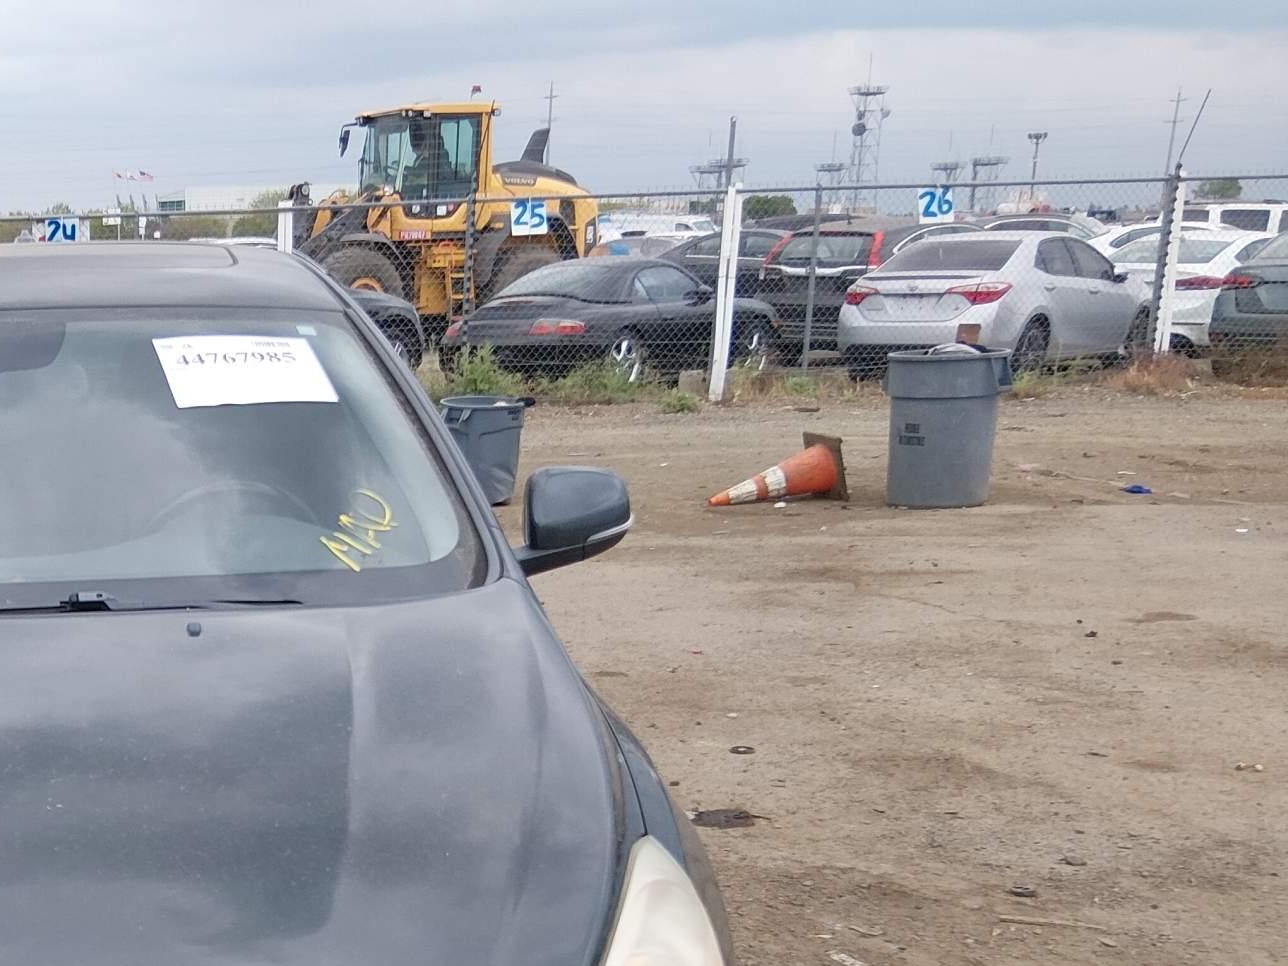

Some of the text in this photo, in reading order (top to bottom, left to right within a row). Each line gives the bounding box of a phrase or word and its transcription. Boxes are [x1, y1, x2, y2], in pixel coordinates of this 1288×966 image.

[512, 201, 545, 228] 25
[918, 188, 953, 218] 26
[176, 351, 297, 367] 44767985
